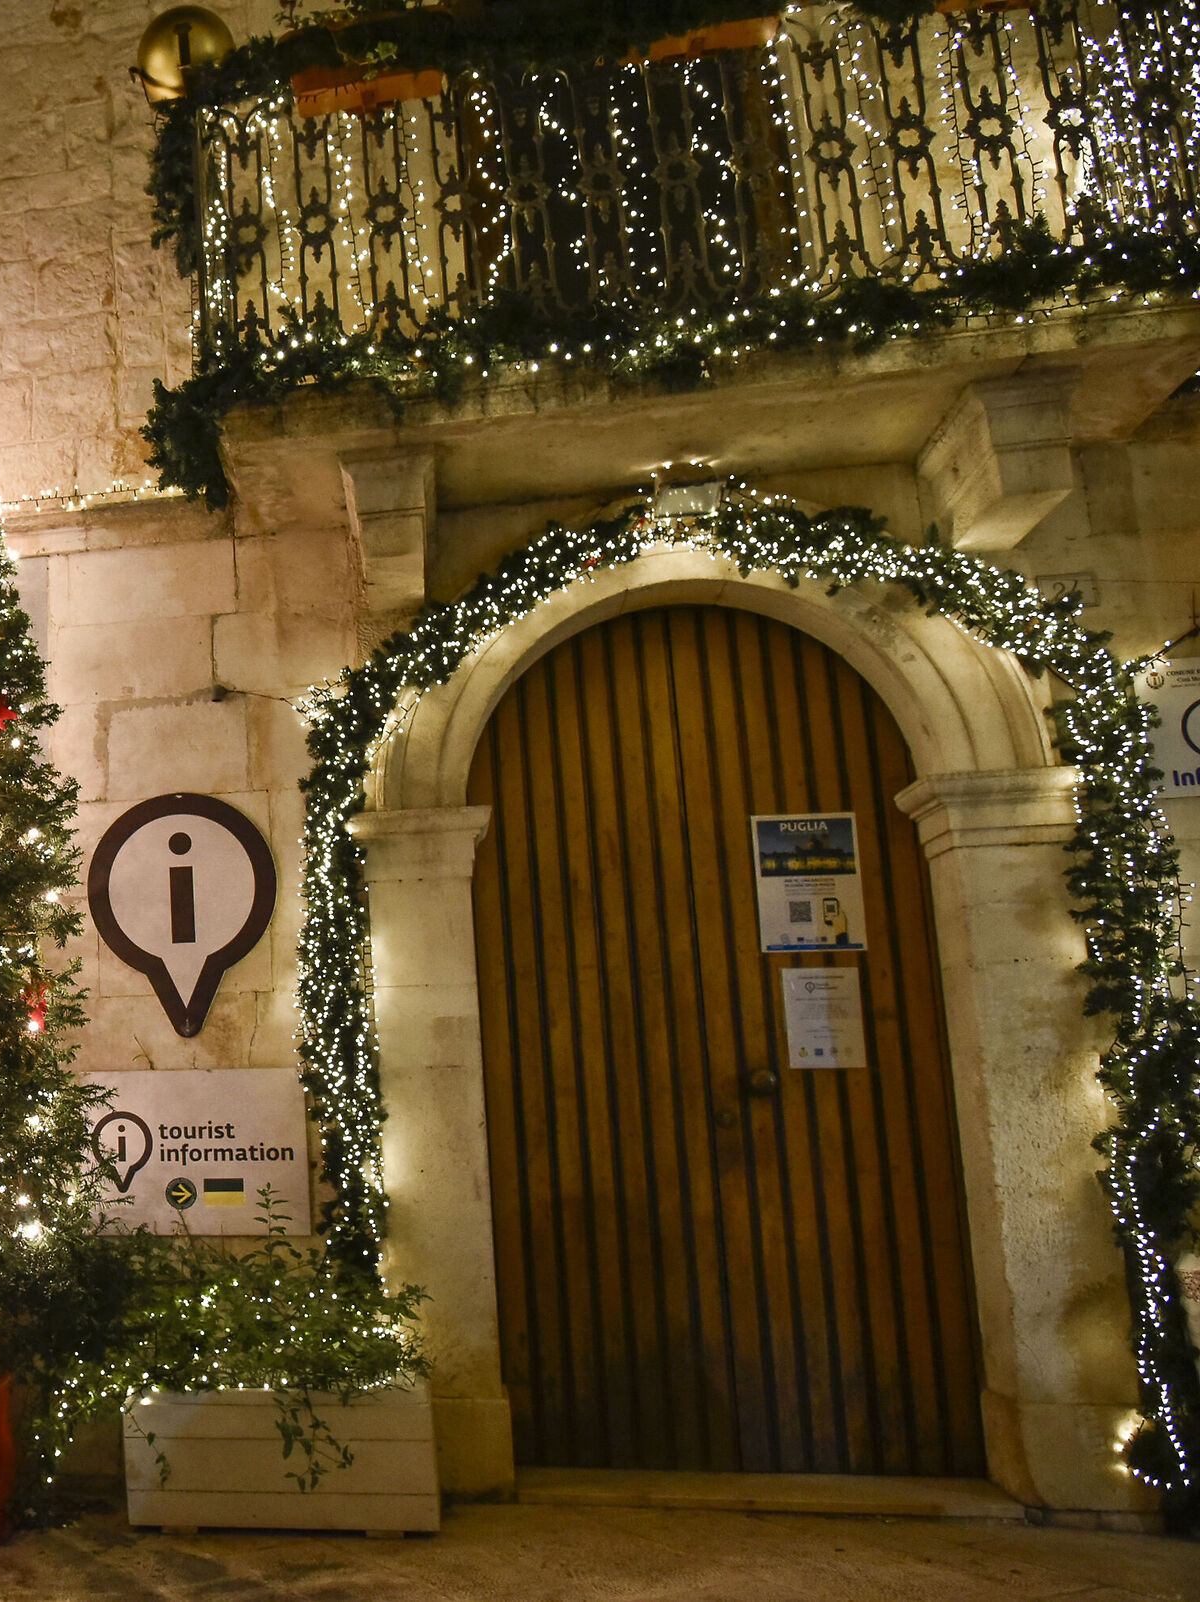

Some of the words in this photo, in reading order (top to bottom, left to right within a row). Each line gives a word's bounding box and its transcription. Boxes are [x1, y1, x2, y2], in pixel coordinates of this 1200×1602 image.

[780, 821, 828, 833] PUGLIA
[159, 1121, 235, 1139] tourist
[160, 1143, 295, 1166] information
